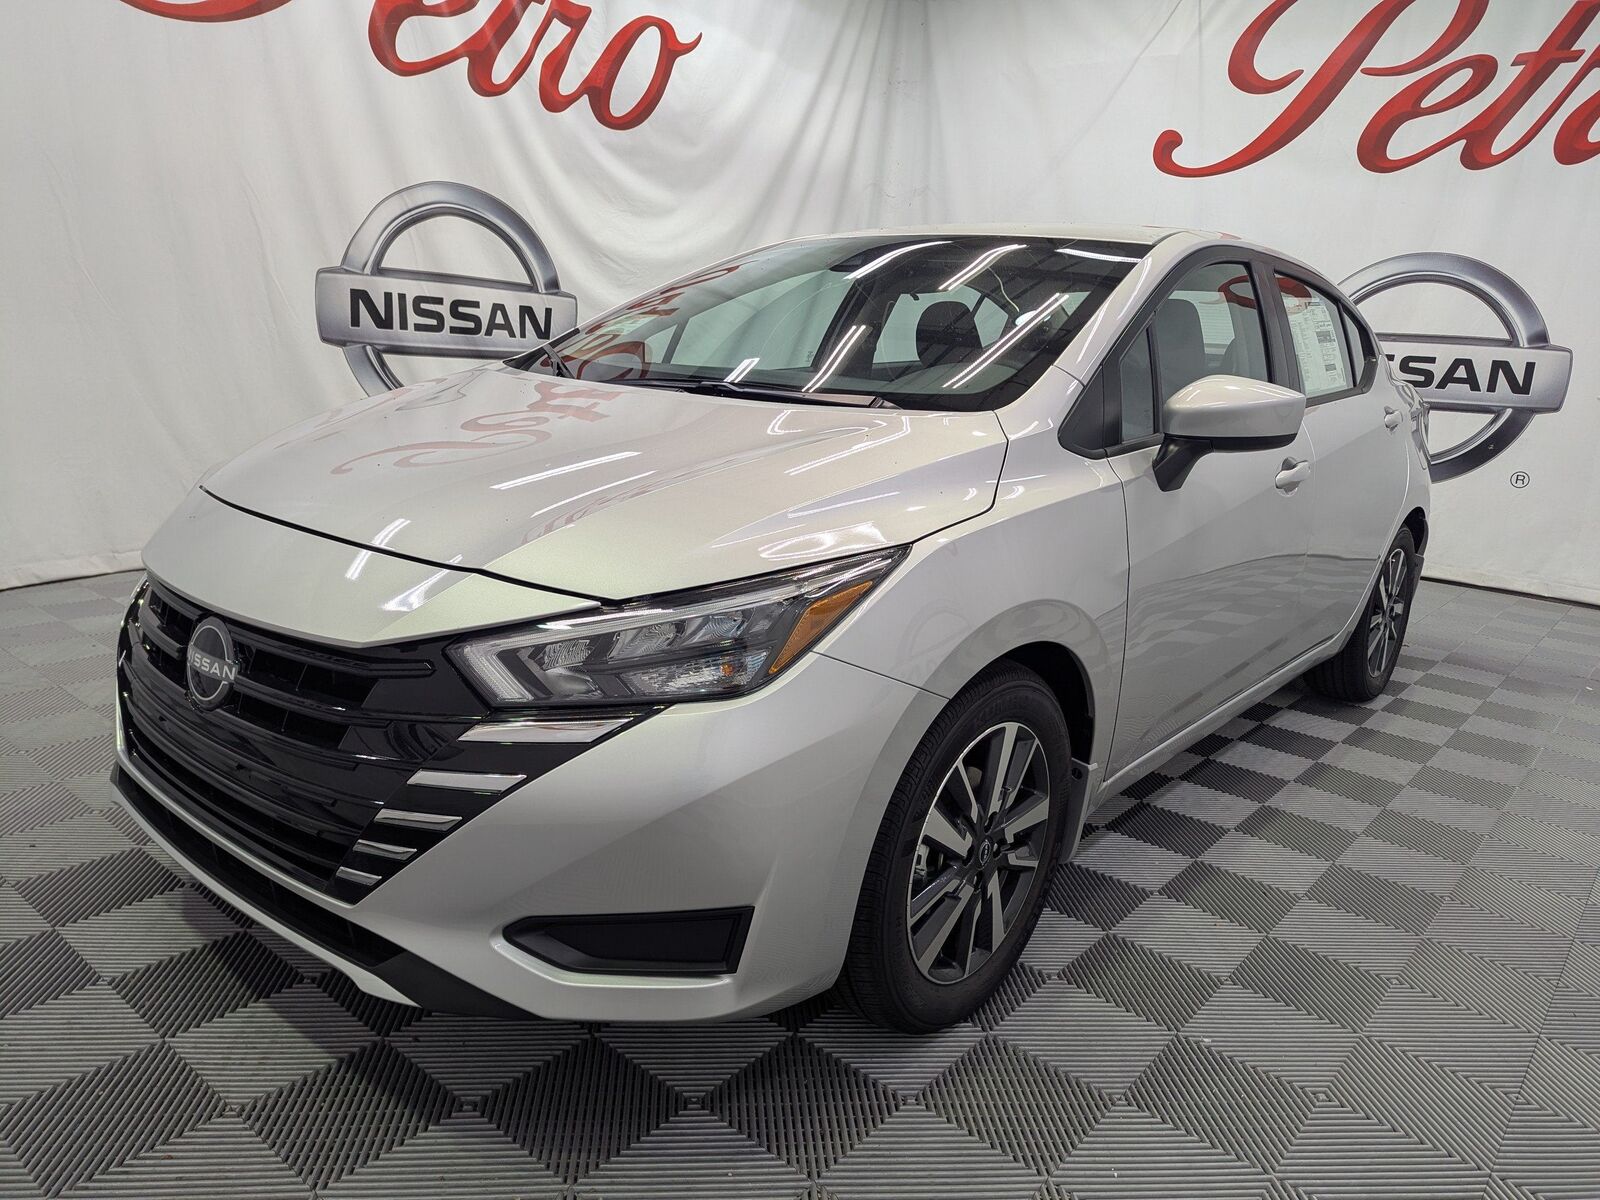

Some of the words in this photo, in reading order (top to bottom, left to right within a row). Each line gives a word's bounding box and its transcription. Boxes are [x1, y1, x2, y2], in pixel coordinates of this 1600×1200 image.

[116, 0, 702, 130] etro
[350, 288, 552, 340] NISSAN
[1386, 354, 1536, 395] SAN
